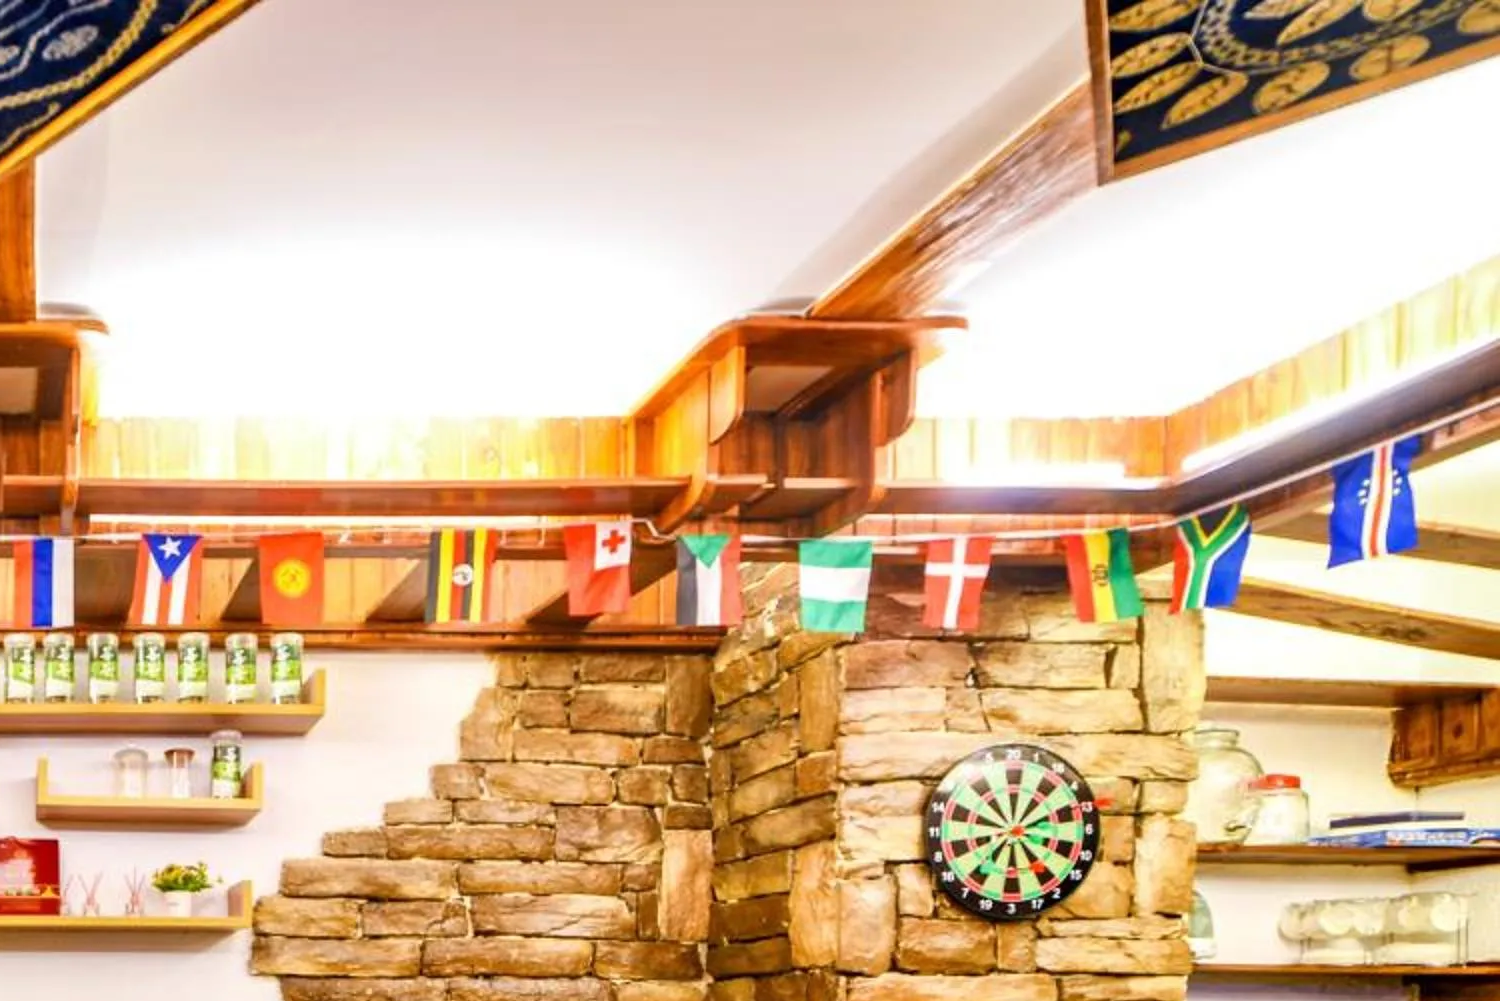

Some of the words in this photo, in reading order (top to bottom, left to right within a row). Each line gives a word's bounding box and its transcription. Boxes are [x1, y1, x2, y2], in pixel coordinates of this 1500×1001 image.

[932, 801, 946, 813] 14
[929, 827, 940, 838] 11
[1085, 823, 1093, 835] 6
[934, 851, 943, 863] 8
[1080, 849, 1093, 861] 10
[961, 887, 970, 899] 7
[1052, 888, 1061, 899] 2
[1006, 903, 1016, 914] 3
[1031, 899, 1044, 909] 17
